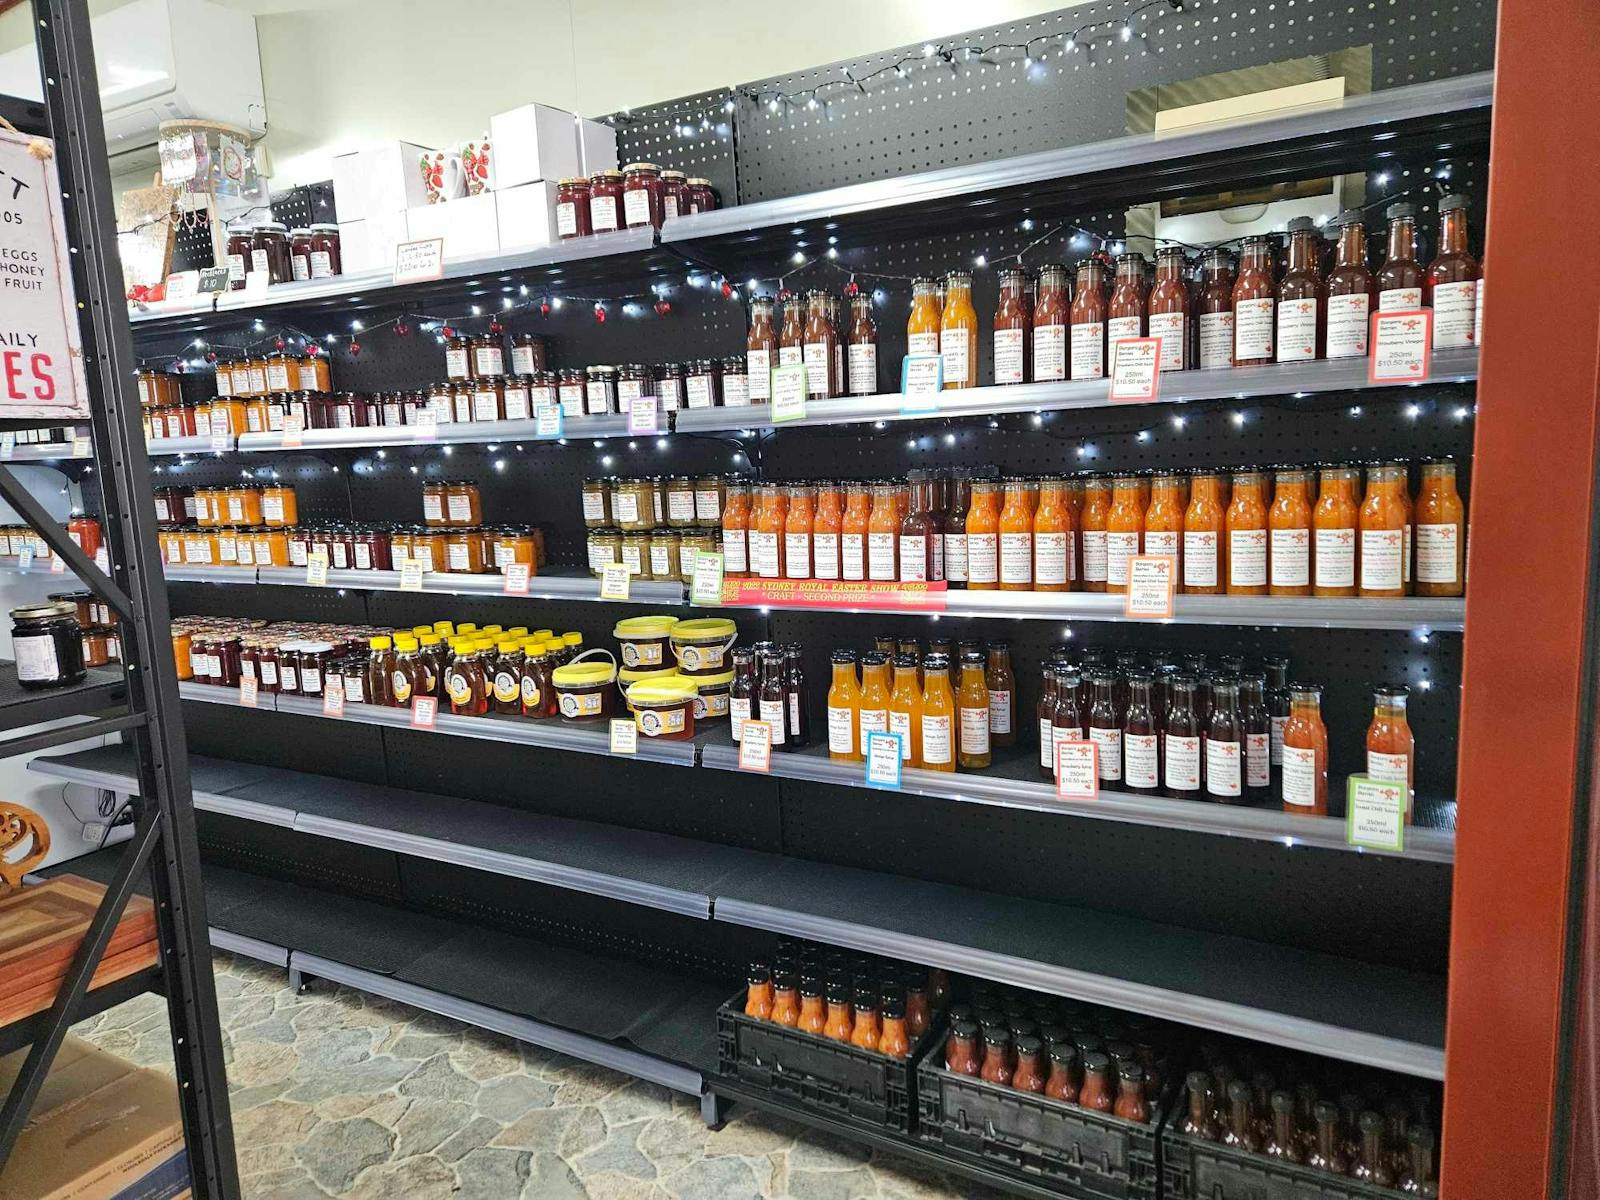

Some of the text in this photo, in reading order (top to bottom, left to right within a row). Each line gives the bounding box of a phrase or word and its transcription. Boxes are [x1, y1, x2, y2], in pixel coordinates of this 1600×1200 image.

[2, 248, 38, 262] EGGS
[0, 262, 45, 277] HONEY
[4, 278, 43, 291] FRUIT
[1389, 351, 1413, 359] 250ml
[763, 582, 797, 591] SYDNEY
[798, 582, 829, 593] ROYAL
[832, 583, 868, 593] EASTER
[871, 583, 900, 594] SHOW
[767, 591, 870, 603] CRAFT SECOND PRIZE
[1358, 825, 1379, 833] $10.50
